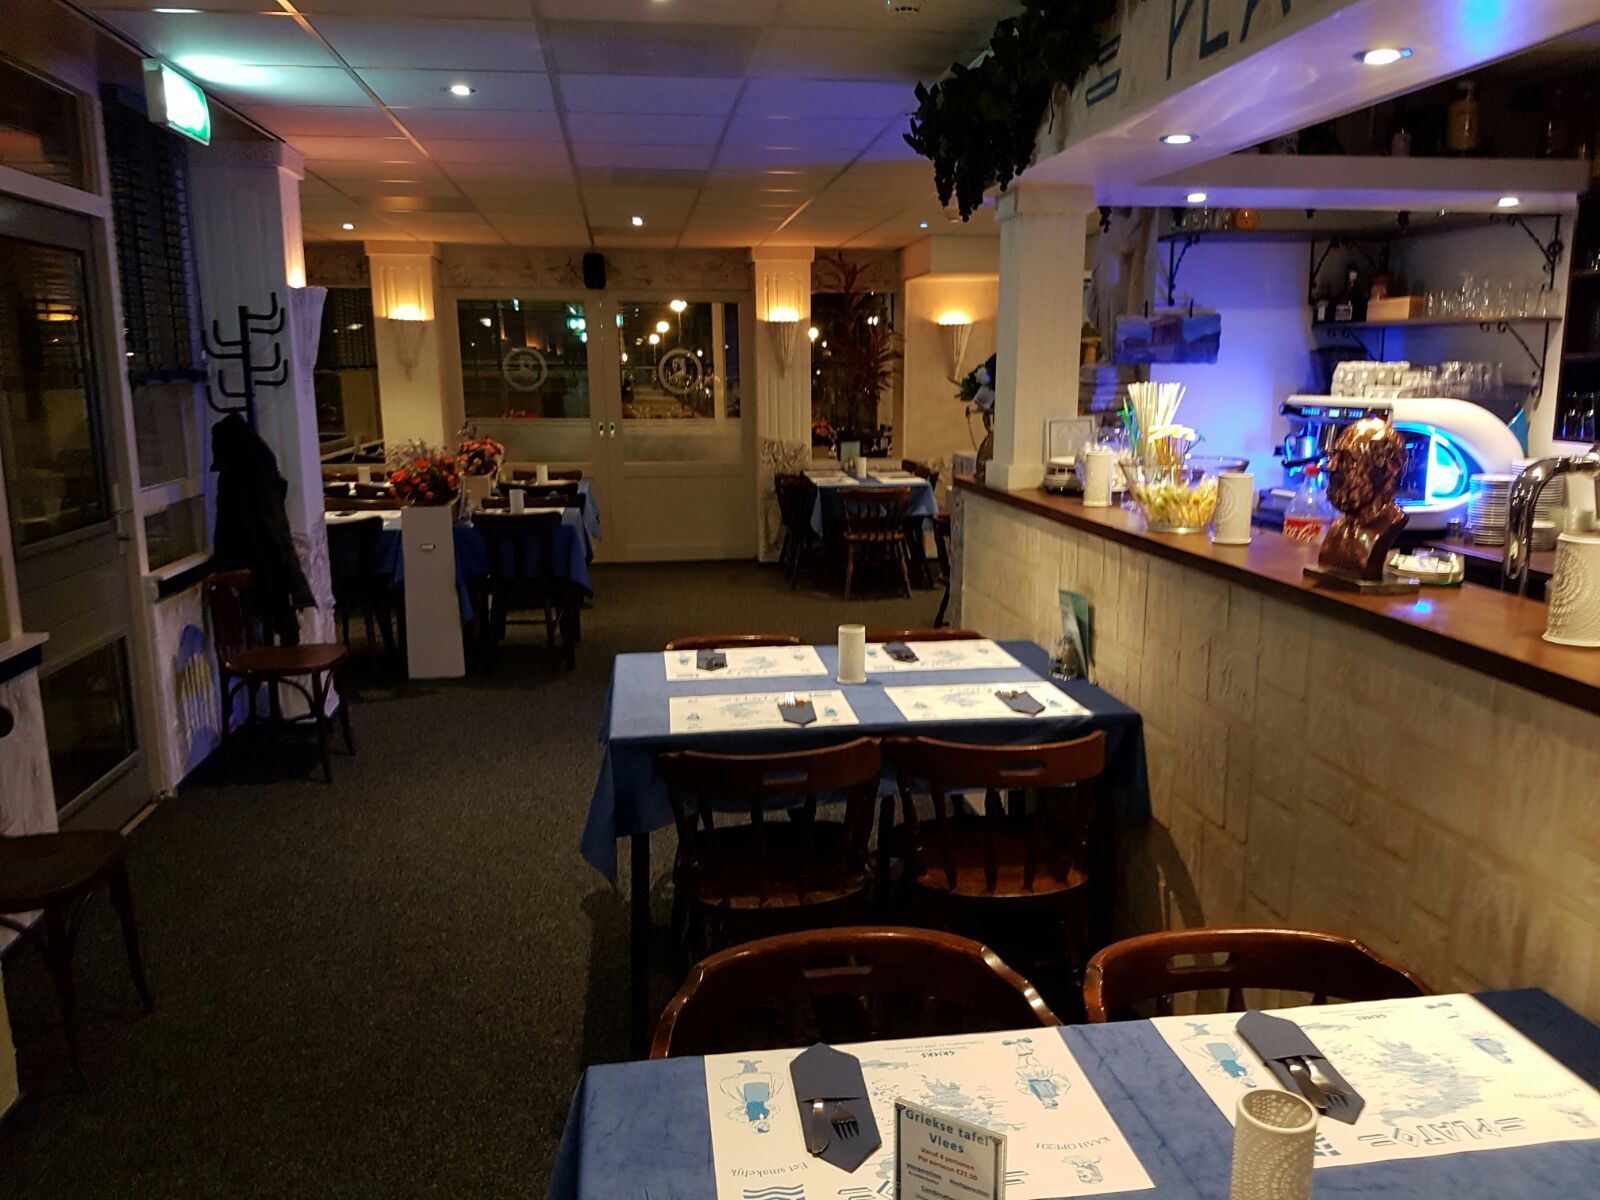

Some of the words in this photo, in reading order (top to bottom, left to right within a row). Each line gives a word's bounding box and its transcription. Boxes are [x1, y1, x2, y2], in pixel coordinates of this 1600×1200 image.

[905, 1109, 953, 1134] Griekse
[958, 1128, 989, 1146] tafel
[929, 1132, 964, 1153] Vlees
[788, 1162, 809, 1173] Eet
[918, 1154, 928, 1162] Per
[929, 1160, 955, 1173] persoon
[920, 1147, 939, 1157] Vanaf
[945, 1156, 975, 1171] personen
[728, 1166, 786, 1178] smakelijk
